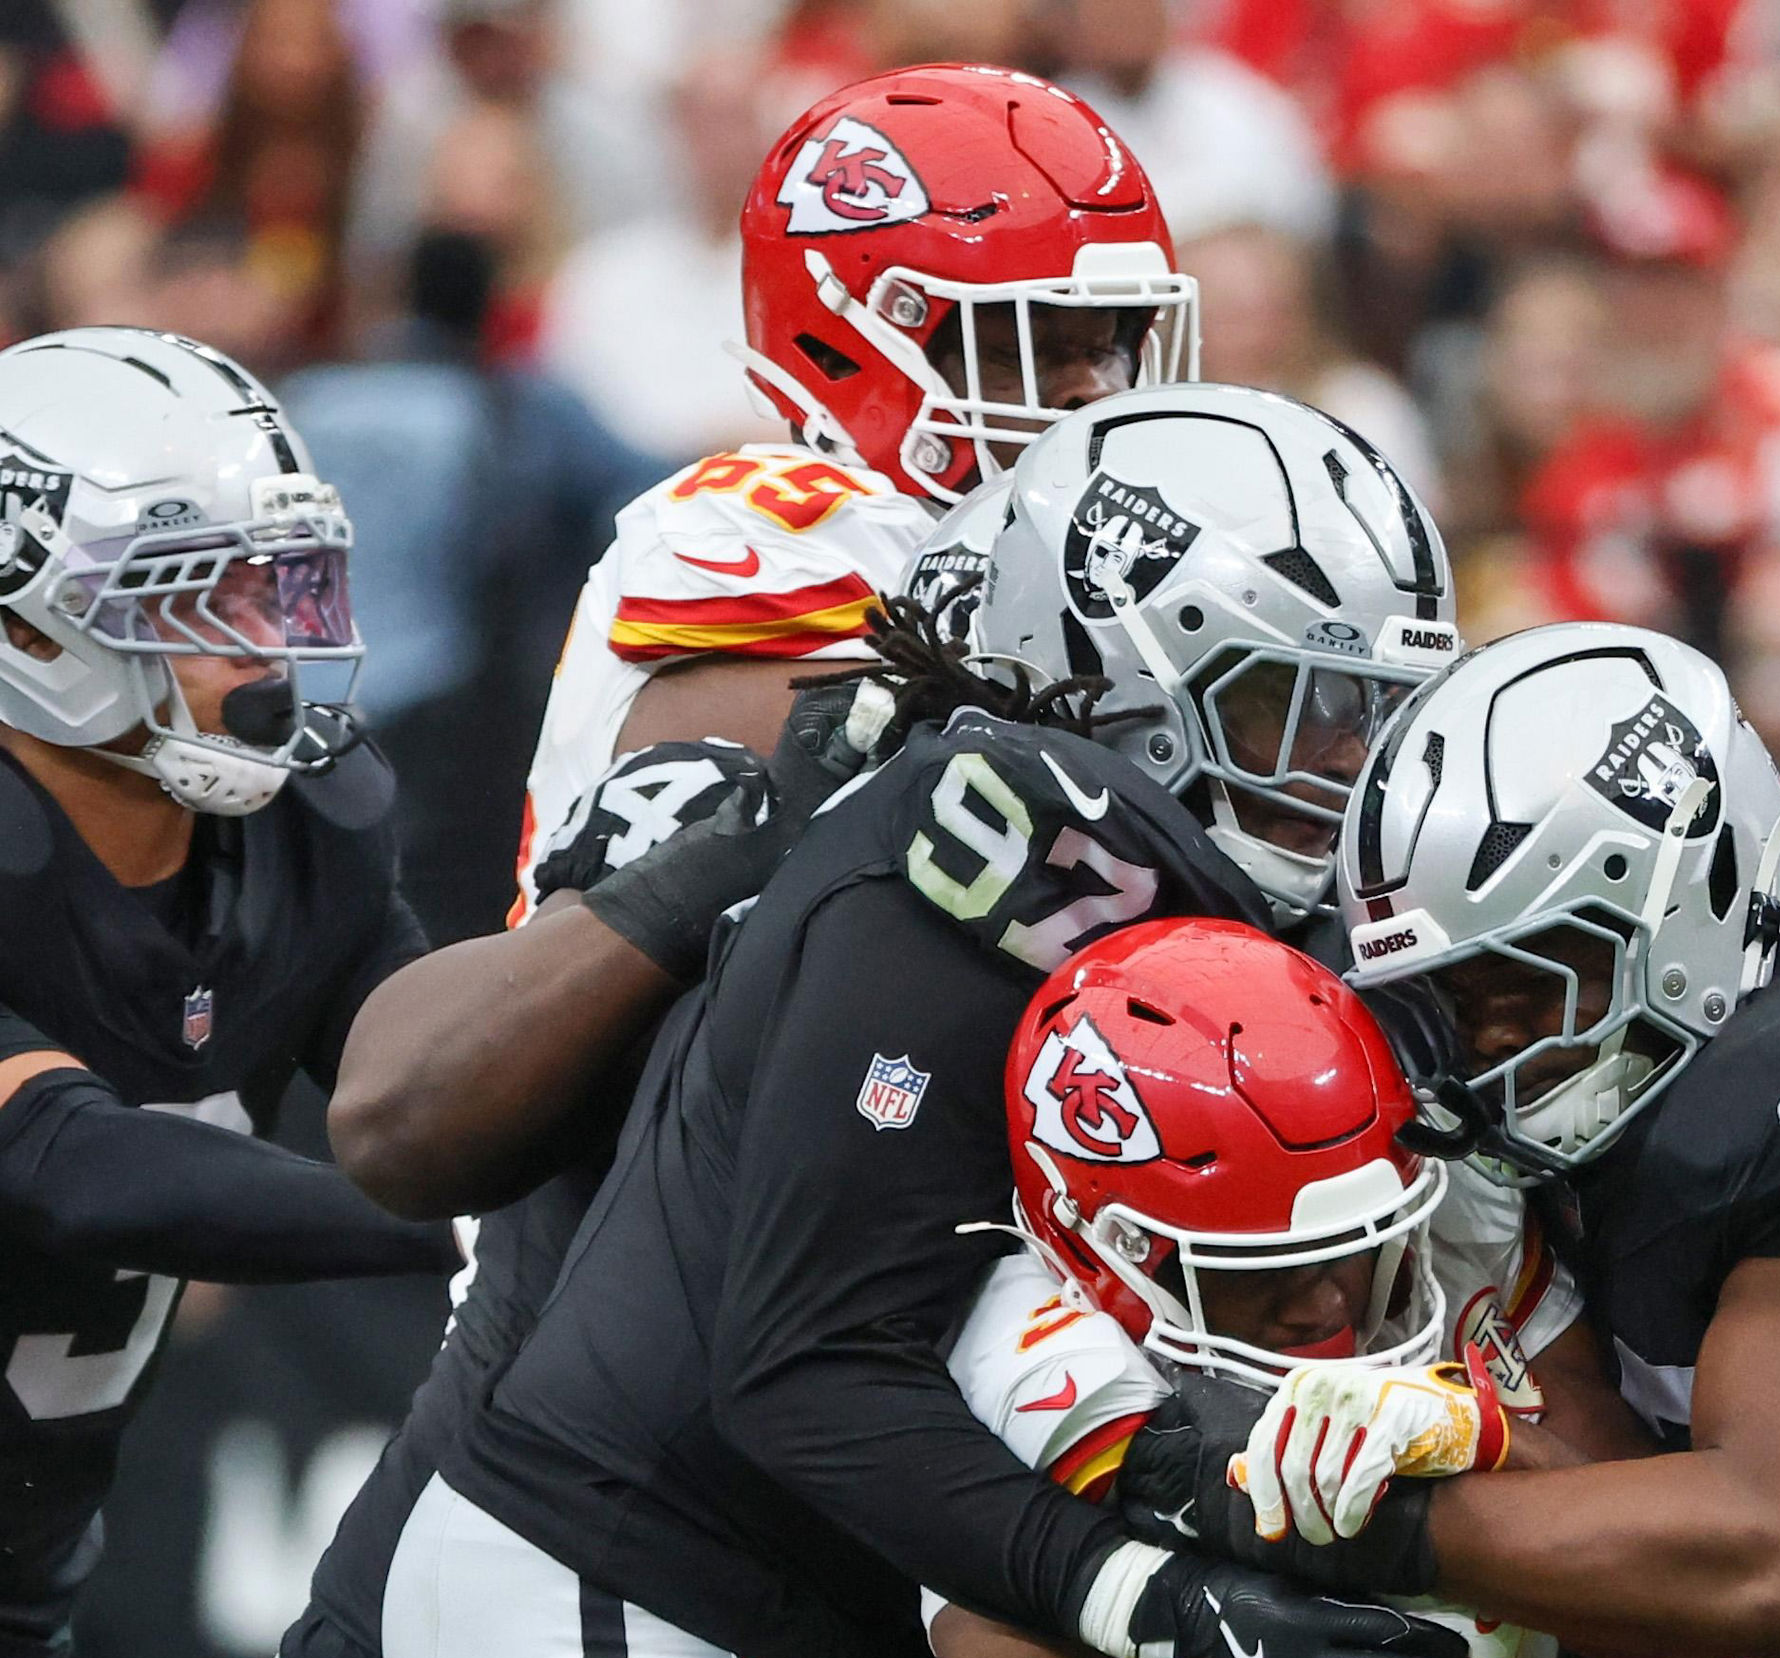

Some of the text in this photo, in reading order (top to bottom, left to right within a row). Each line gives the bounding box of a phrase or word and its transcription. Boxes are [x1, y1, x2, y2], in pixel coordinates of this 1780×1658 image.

[0, 468, 60, 491] DERS
[1098, 482, 1187, 538] RAIDERS
[919, 554, 989, 573] RAIDERS
[1306, 632, 1365, 655] OAKLEY
[1401, 628, 1454, 651] RAIDERS
[1595, 702, 1666, 784] RAIDERS
[904, 752, 1159, 974] 97
[1358, 928, 1418, 961] RAIDERS
[865, 1082, 909, 1119] NFL
[1046, 1044, 1137, 1157] KC
